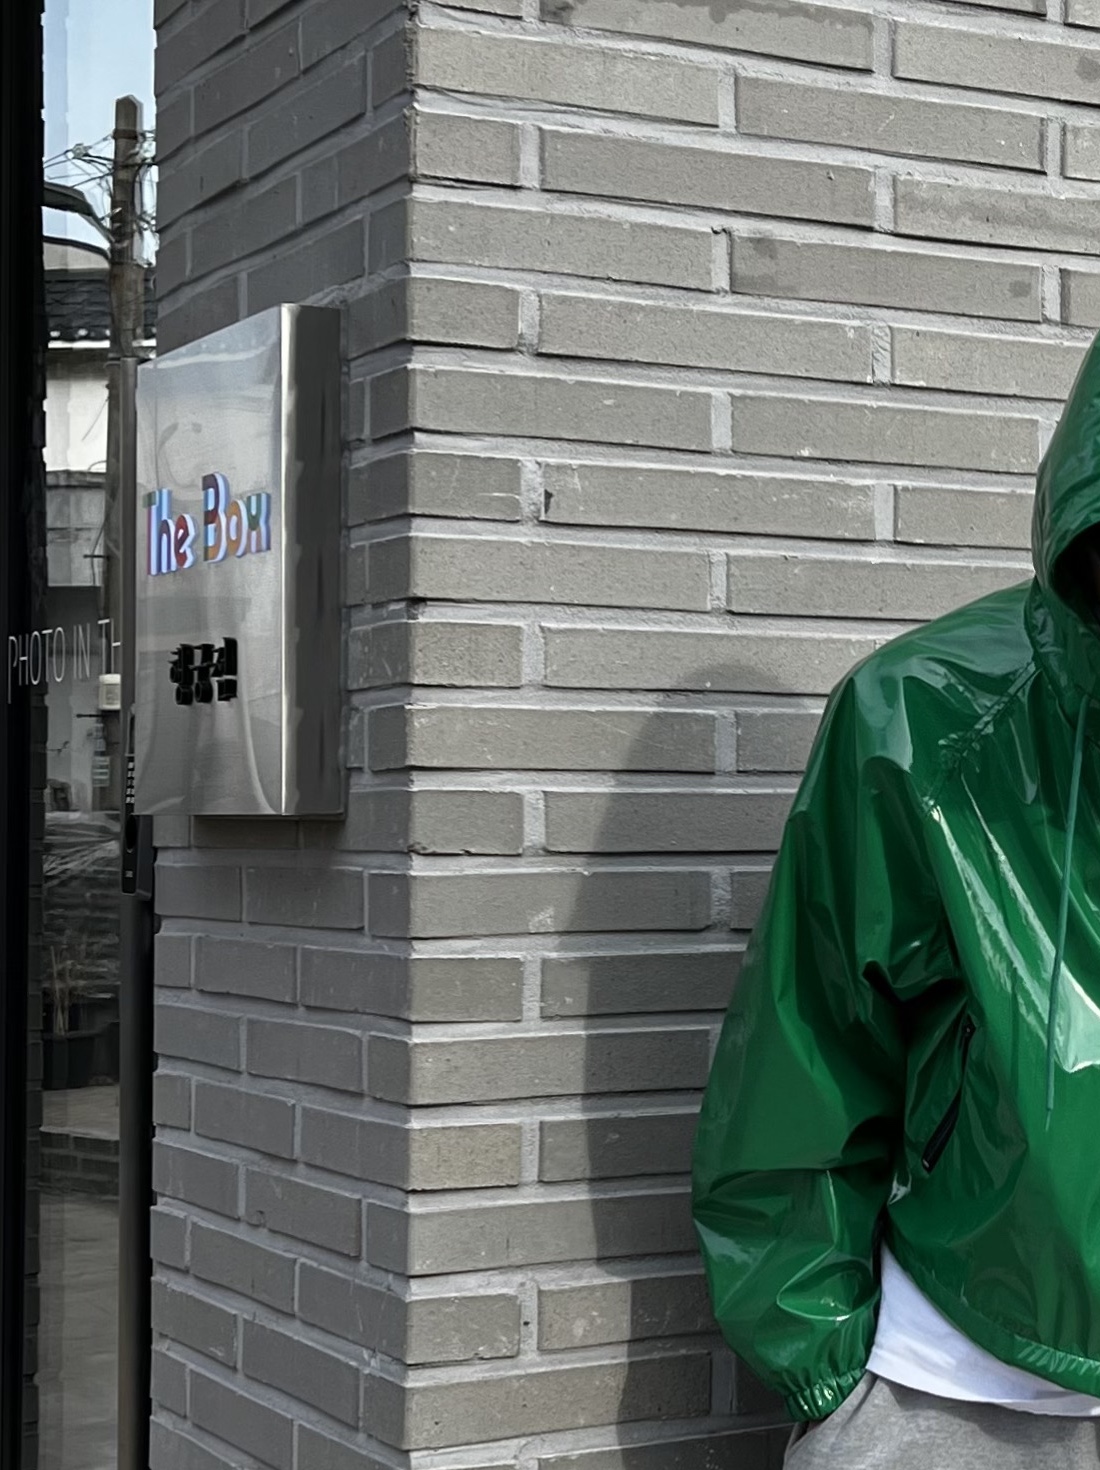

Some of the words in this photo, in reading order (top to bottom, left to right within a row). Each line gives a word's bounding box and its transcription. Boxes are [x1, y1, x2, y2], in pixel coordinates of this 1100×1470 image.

[143, 488, 195, 576] The
[202, 473, 272, 564] Box
[8, 626, 66, 704] PHOTO
[73, 622, 91, 679] IN
